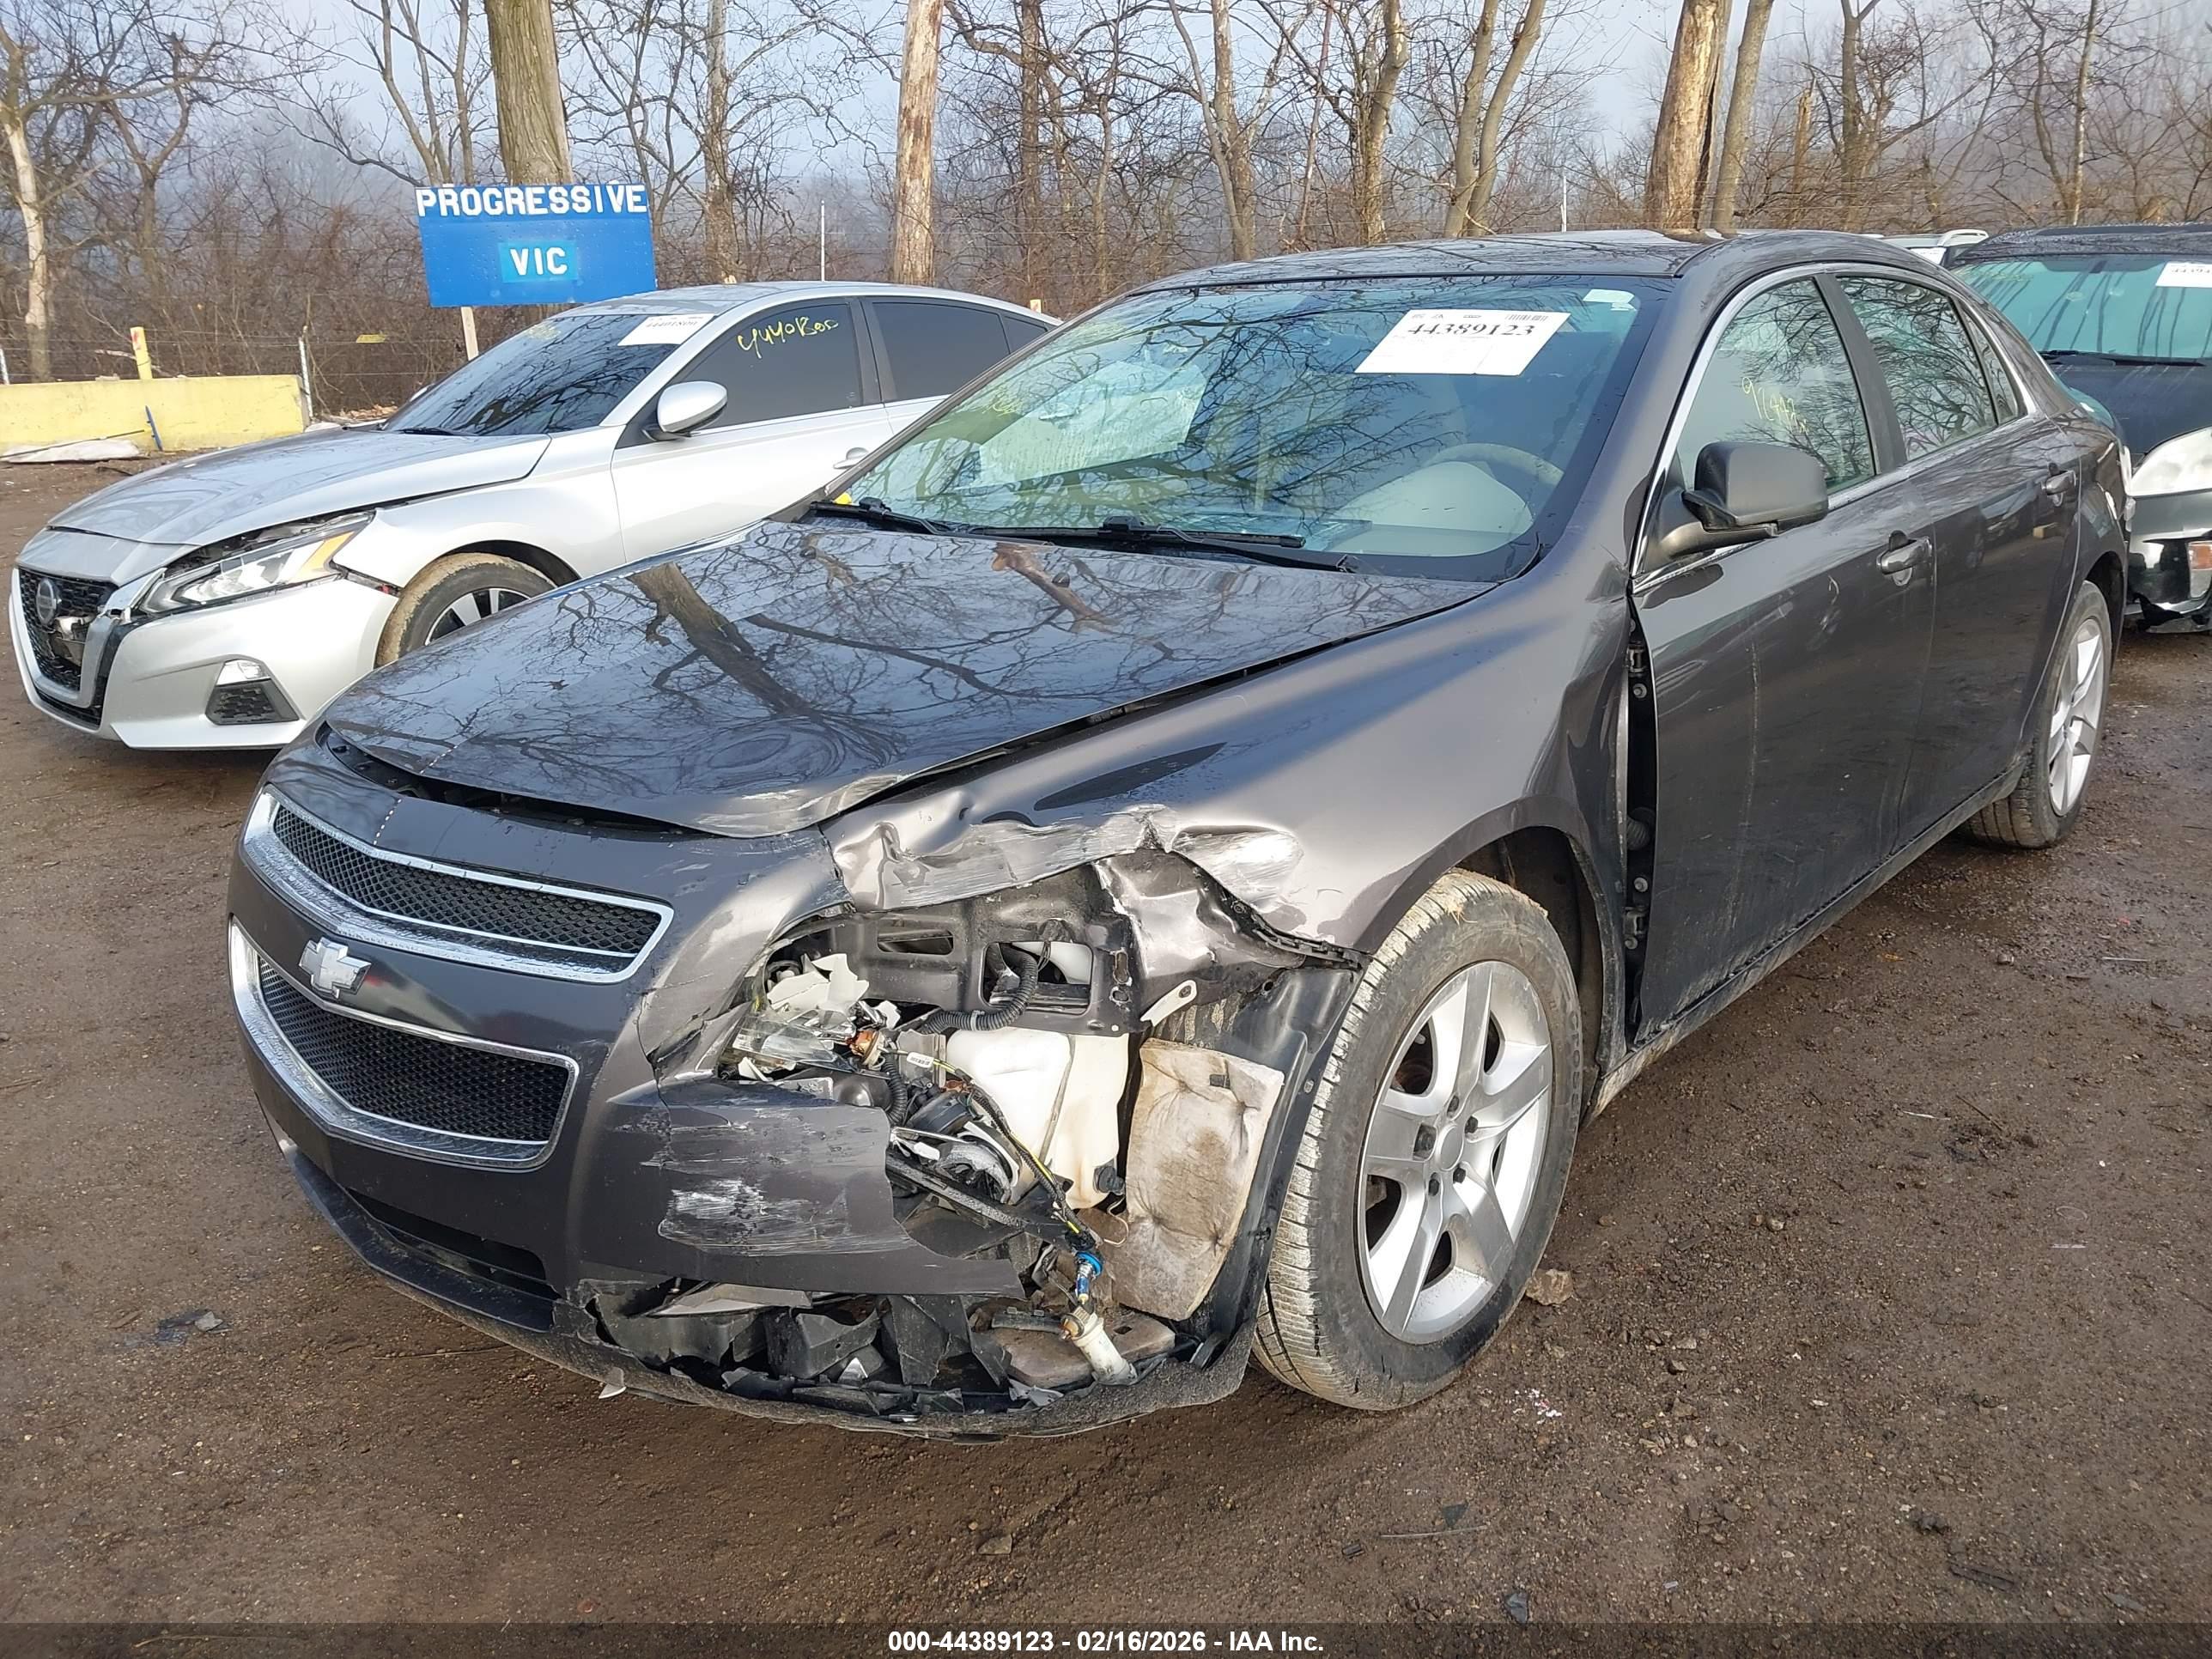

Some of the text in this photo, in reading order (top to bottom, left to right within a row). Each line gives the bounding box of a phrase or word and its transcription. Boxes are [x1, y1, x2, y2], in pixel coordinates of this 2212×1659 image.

[416, 185, 647, 216] PROGRESSIVE
[510, 246, 568, 276] VIC
[1407, 323, 1535, 336] 44389123
